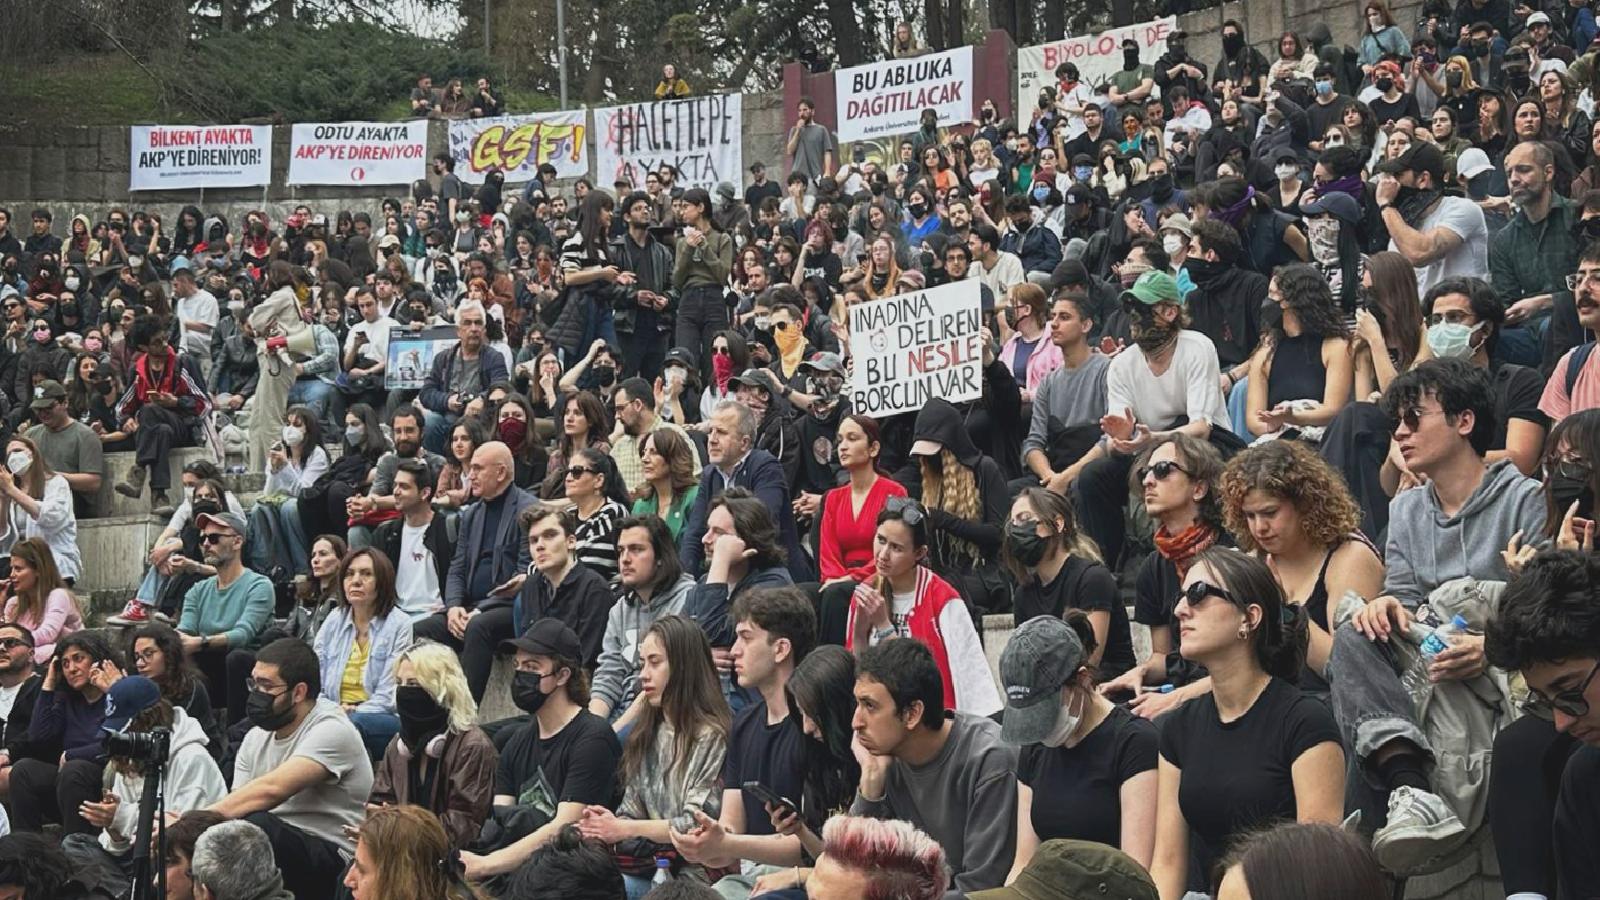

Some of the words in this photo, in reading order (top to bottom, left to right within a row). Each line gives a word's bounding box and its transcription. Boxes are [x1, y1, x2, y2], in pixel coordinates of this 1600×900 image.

[1146, 24, 1169, 47] DE
[852, 70, 877, 93] BU
[882, 57, 952, 88] ABLUKA
[847, 80, 963, 120] DAĞITILACAK
[150, 128, 202, 147] BİLKENT
[204, 128, 253, 144] AYAKTA
[356, 126, 408, 141] AYAKTA
[618, 94, 732, 155] HACETTEPE
[139, 149, 185, 168] AKP'YE
[188, 145, 261, 167] DİRENİYOR!
[295, 144, 346, 160] AKP'YE
[347, 143, 423, 160] DİRENİYOR
[469, 121, 585, 173] GSF!
[622, 152, 719, 188] AYKTA
[867, 354, 896, 385] BU
[936, 366, 979, 397] VAR
